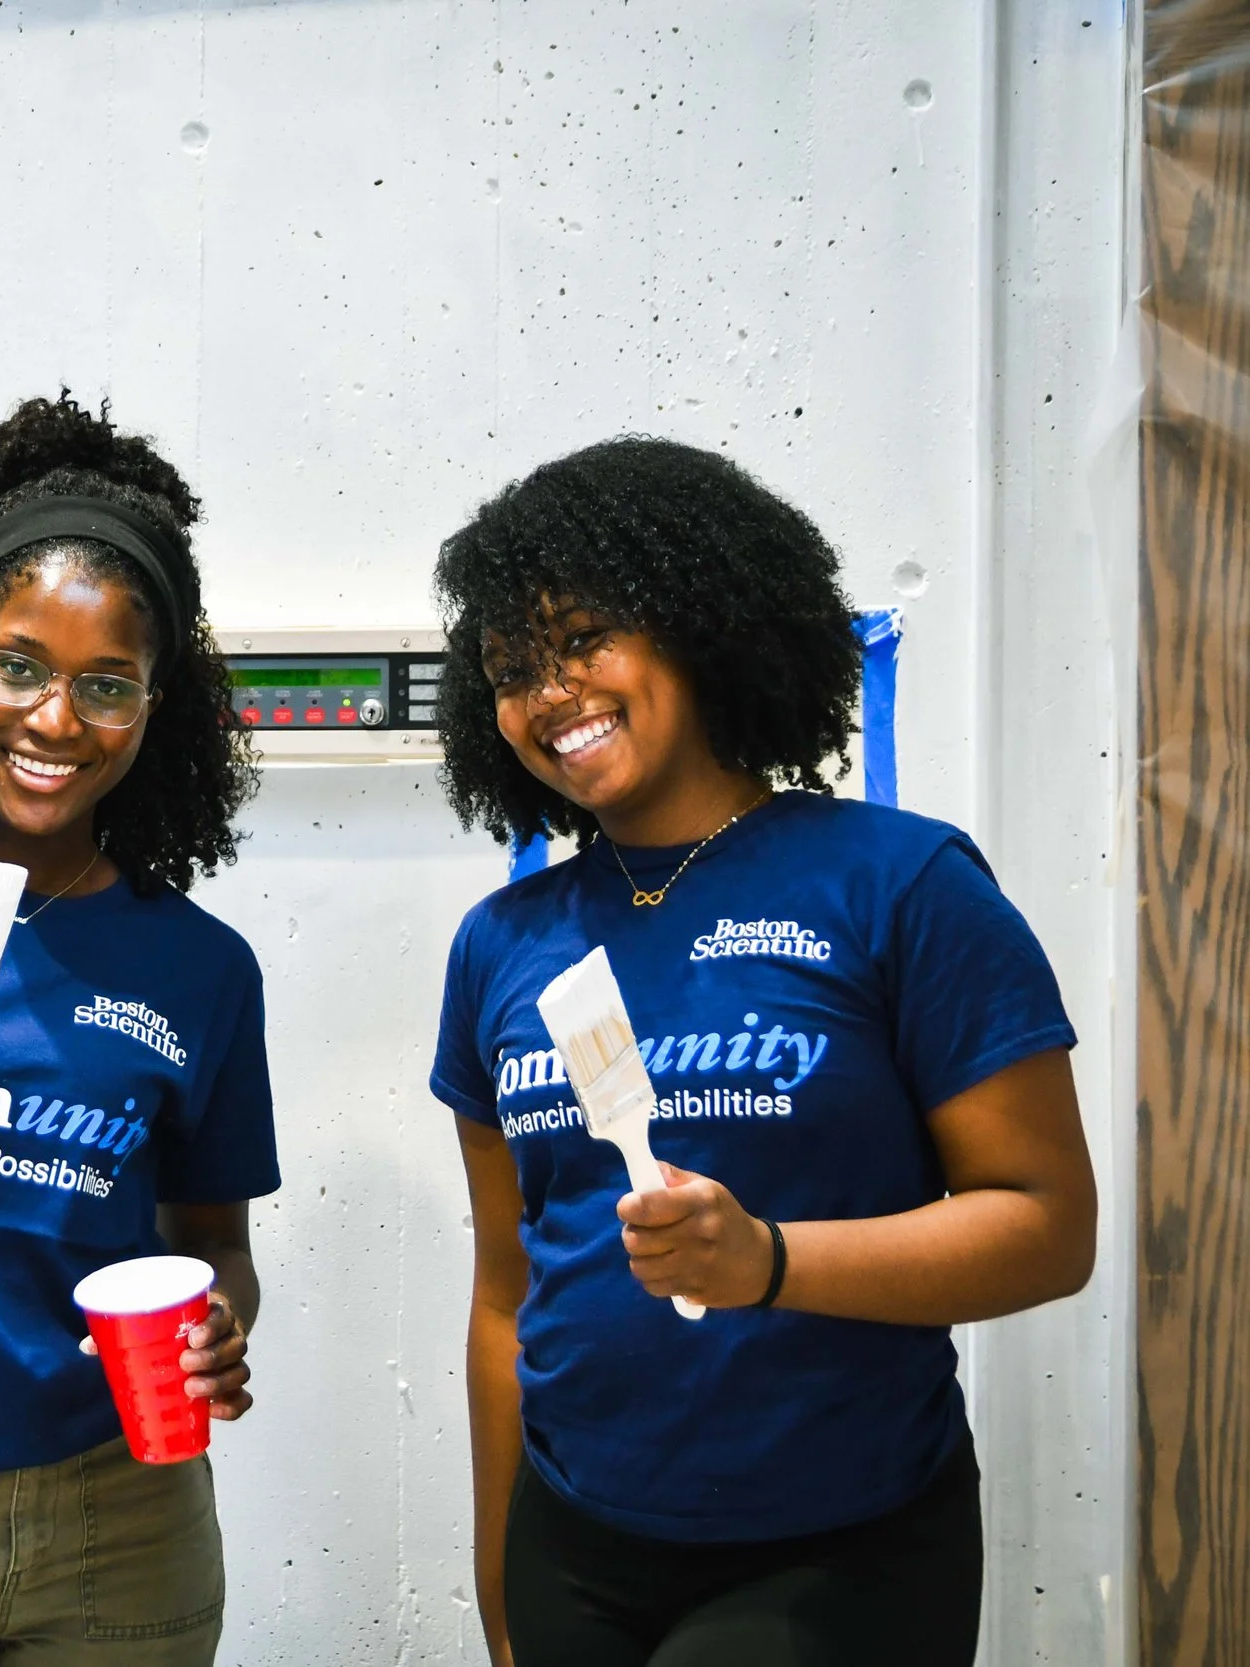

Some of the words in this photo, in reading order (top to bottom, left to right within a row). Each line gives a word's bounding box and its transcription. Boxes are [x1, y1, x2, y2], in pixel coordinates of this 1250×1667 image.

[689, 929, 832, 960] Scientific
[712, 917, 799, 940] Boston
[73, 1005, 187, 1067] Scientific
[93, 994, 169, 1035] Boston
[497, 1012, 829, 1102] omunity
[500, 1100, 584, 1140] Advancin
[649, 1088, 793, 1119] ssibilities
